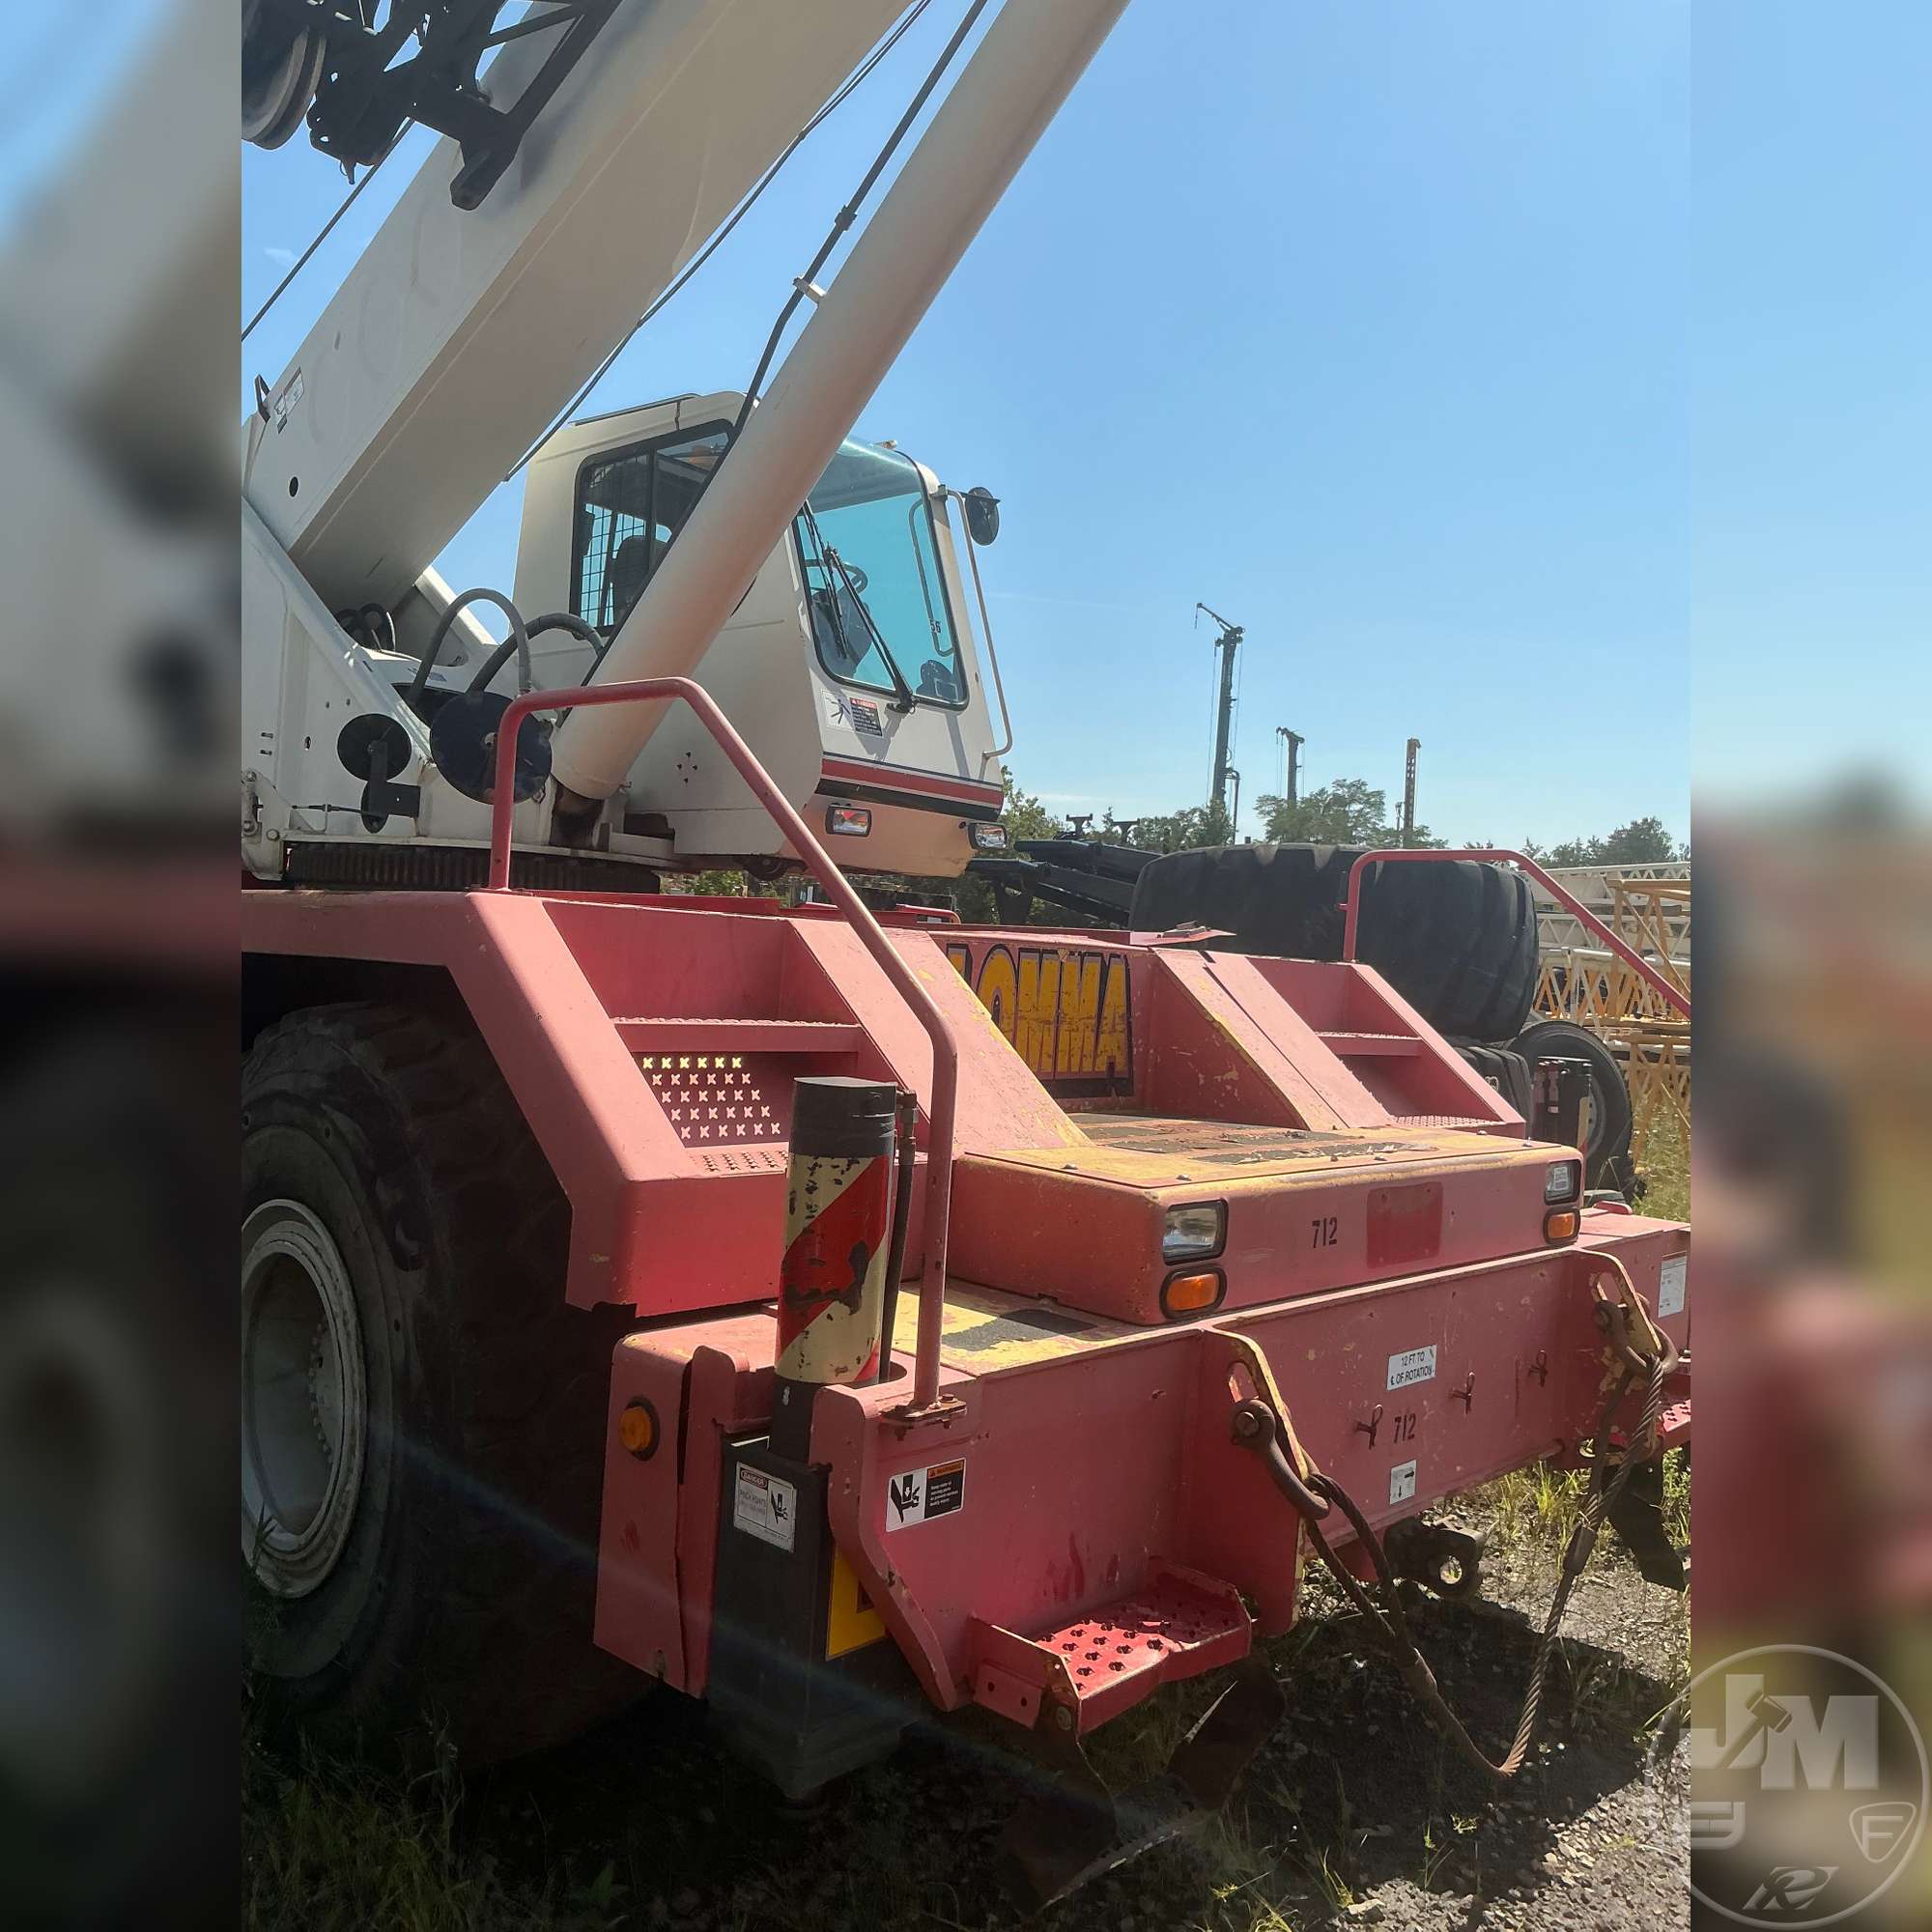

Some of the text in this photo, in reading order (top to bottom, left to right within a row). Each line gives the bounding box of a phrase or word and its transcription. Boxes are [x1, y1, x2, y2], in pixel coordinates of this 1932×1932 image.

[947, 943, 1133, 1097] OMMA
[1311, 1216, 1338, 1249] 712
[1401, 1350, 1426, 1367] 12 FT TO
[1395, 1372, 1405, 1384] OF
[1393, 1412, 1416, 1444] 712
